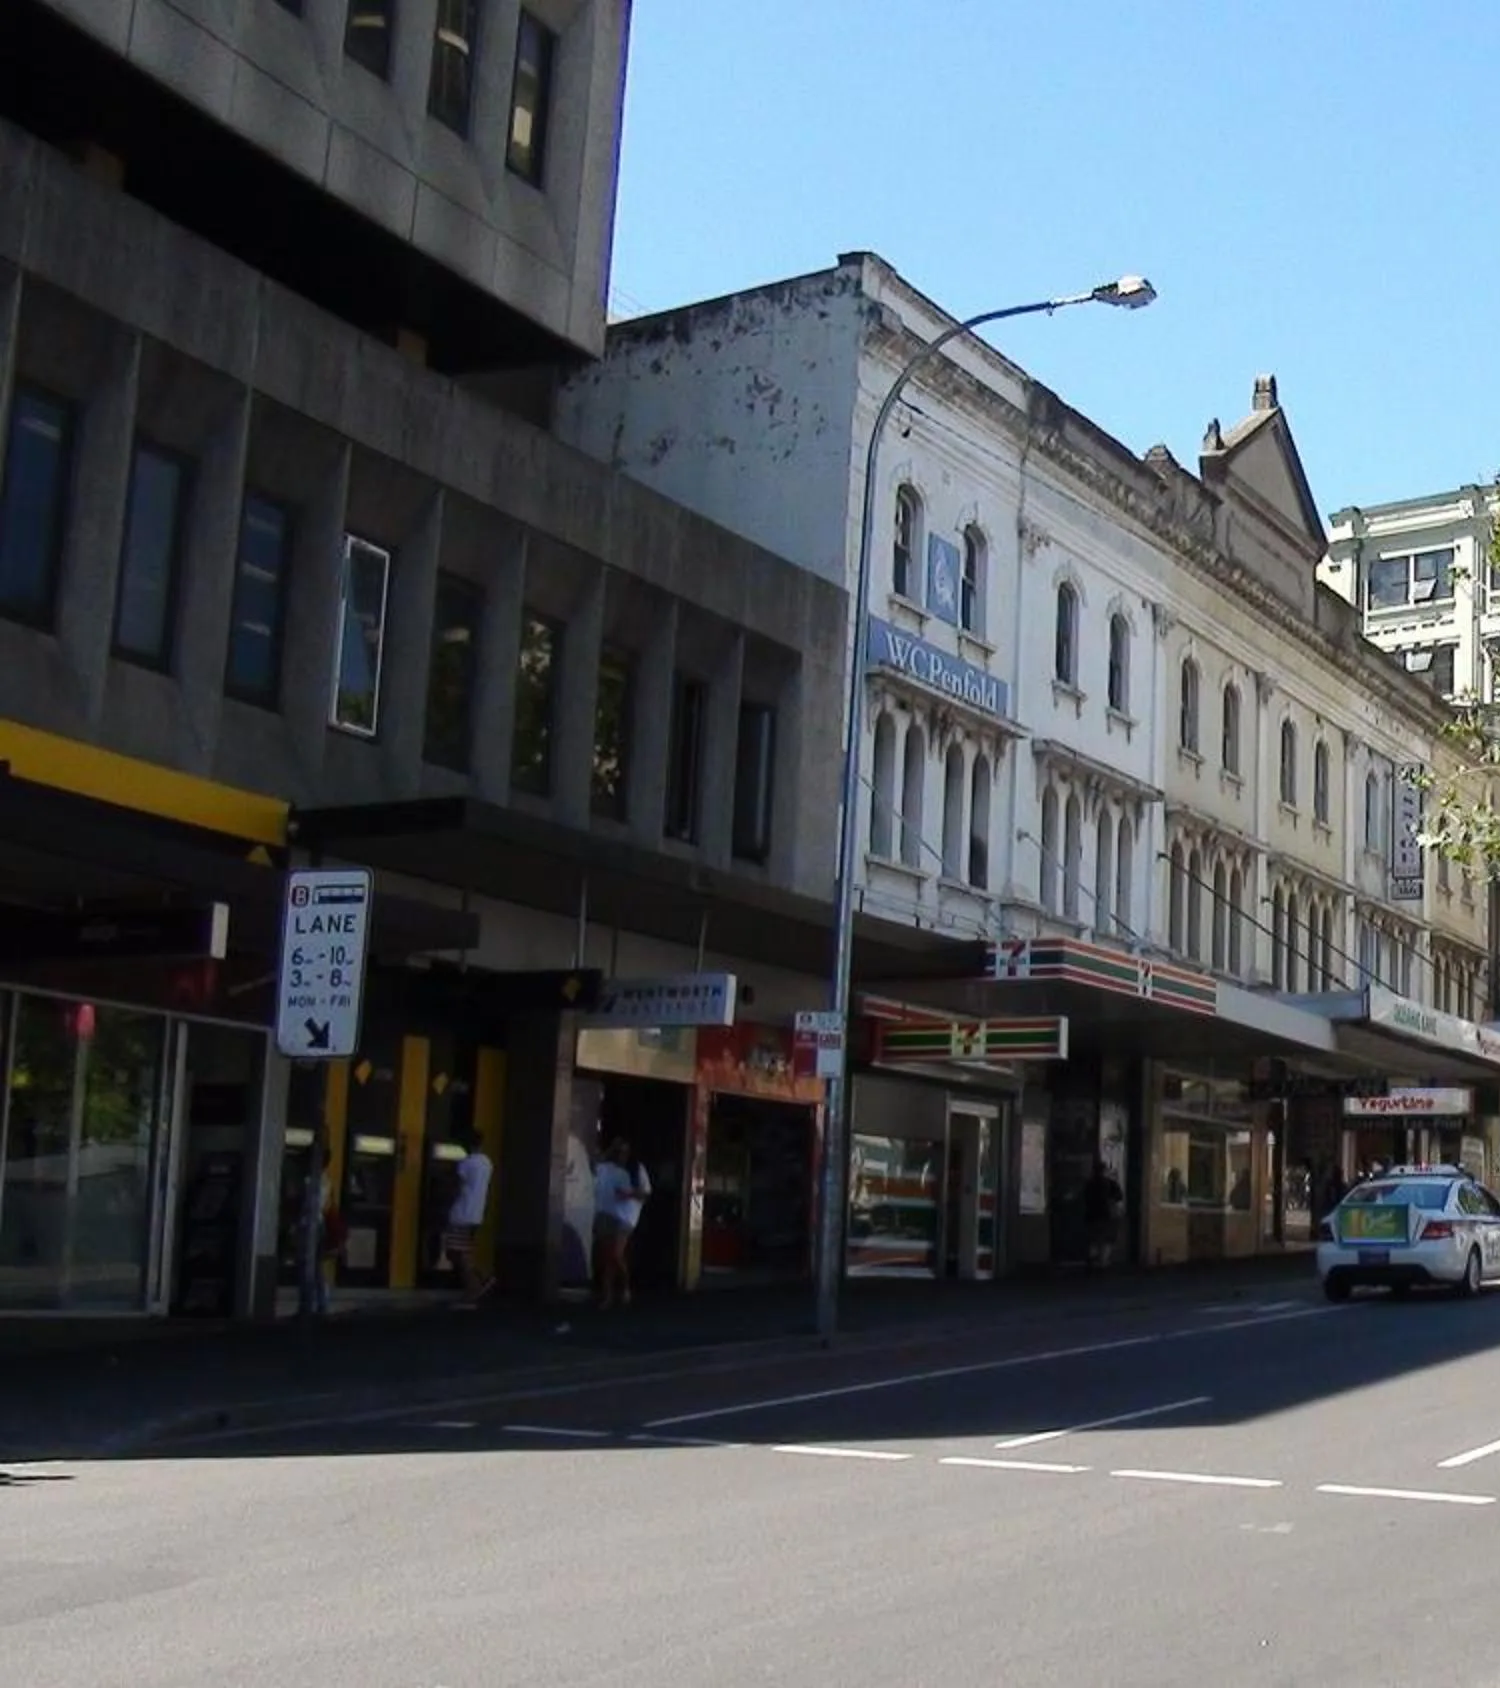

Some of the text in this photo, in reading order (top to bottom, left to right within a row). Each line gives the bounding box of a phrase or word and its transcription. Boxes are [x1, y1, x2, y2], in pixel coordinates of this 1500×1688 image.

[930, 654, 997, 712] Penfold
[295, 914, 357, 934] LANE
[288, 995, 317, 1009] MON
[330, 994, 351, 1008] FRI
